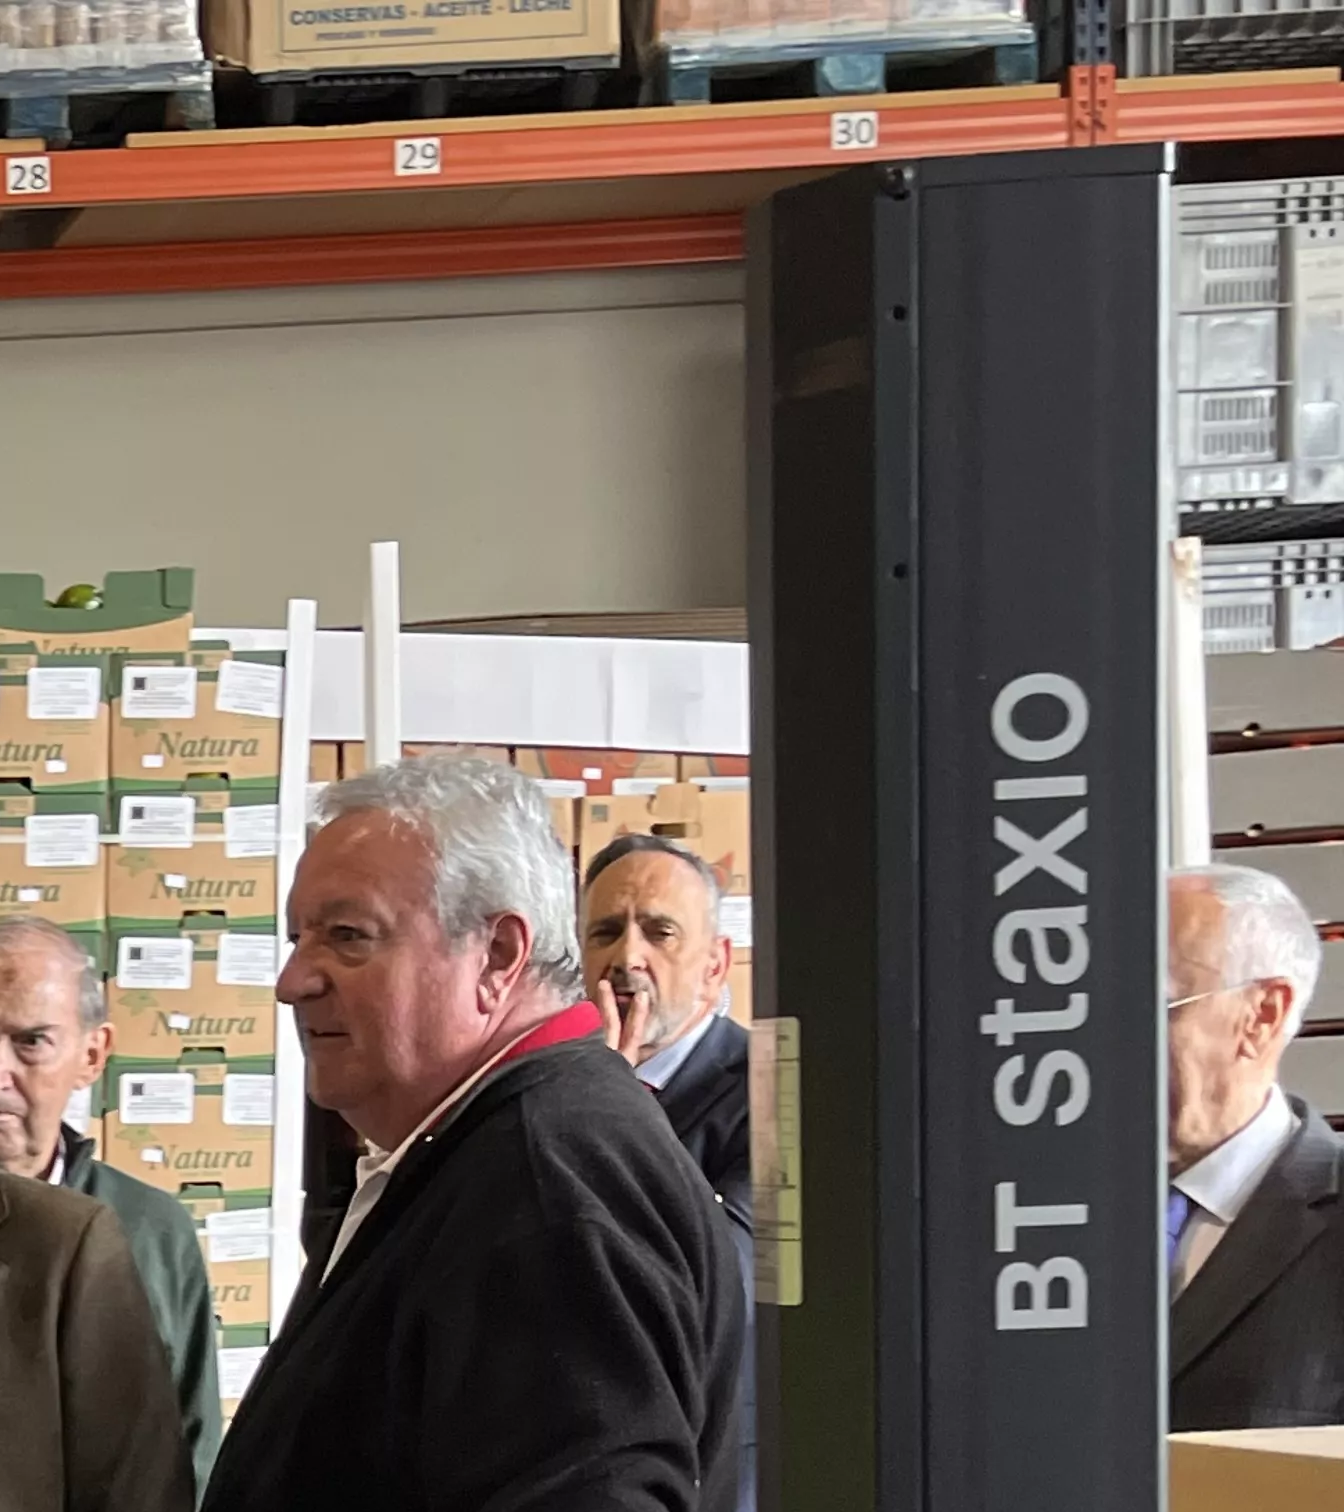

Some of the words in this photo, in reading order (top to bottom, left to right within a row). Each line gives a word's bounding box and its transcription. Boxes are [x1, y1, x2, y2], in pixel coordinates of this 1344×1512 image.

[290, 4, 406, 26] CONSERVAS
[422, 0, 492, 18] ACEITE
[509, 0, 572, 13] LECHE
[836, 118, 875, 145] 30
[401, 143, 439, 169] 29
[10, 164, 48, 190] 28
[155, 731, 259, 758] Natura
[980, 672, 1090, 1126] staxio
[995, 1181, 1088, 1330] BT
